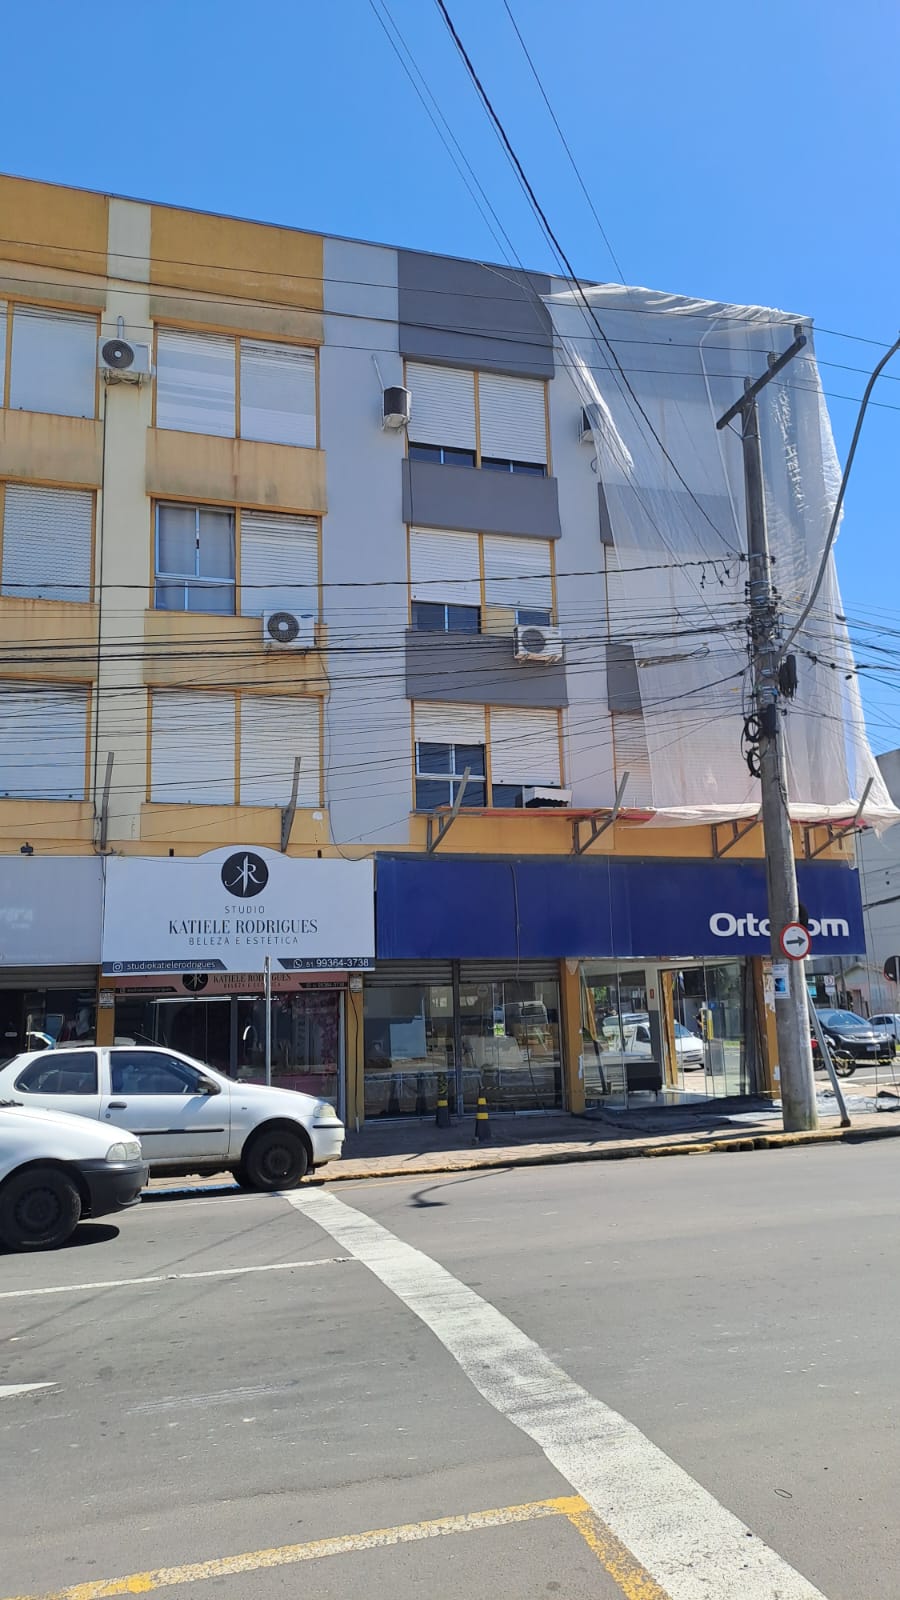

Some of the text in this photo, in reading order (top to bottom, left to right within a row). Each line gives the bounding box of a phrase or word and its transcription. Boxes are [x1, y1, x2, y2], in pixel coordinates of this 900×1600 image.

[225, 905, 265, 914] STUDIO
[169, 918, 318, 935] KATIELE RODRIGUES
[709, 912, 850, 937] Ortoom
[188, 937, 230, 946] BELEZA
[235, 936, 241, 945] E
[126, 960, 216, 970] studiokatielerodrigues
[316, 958, 369, 968] 99364-3738
